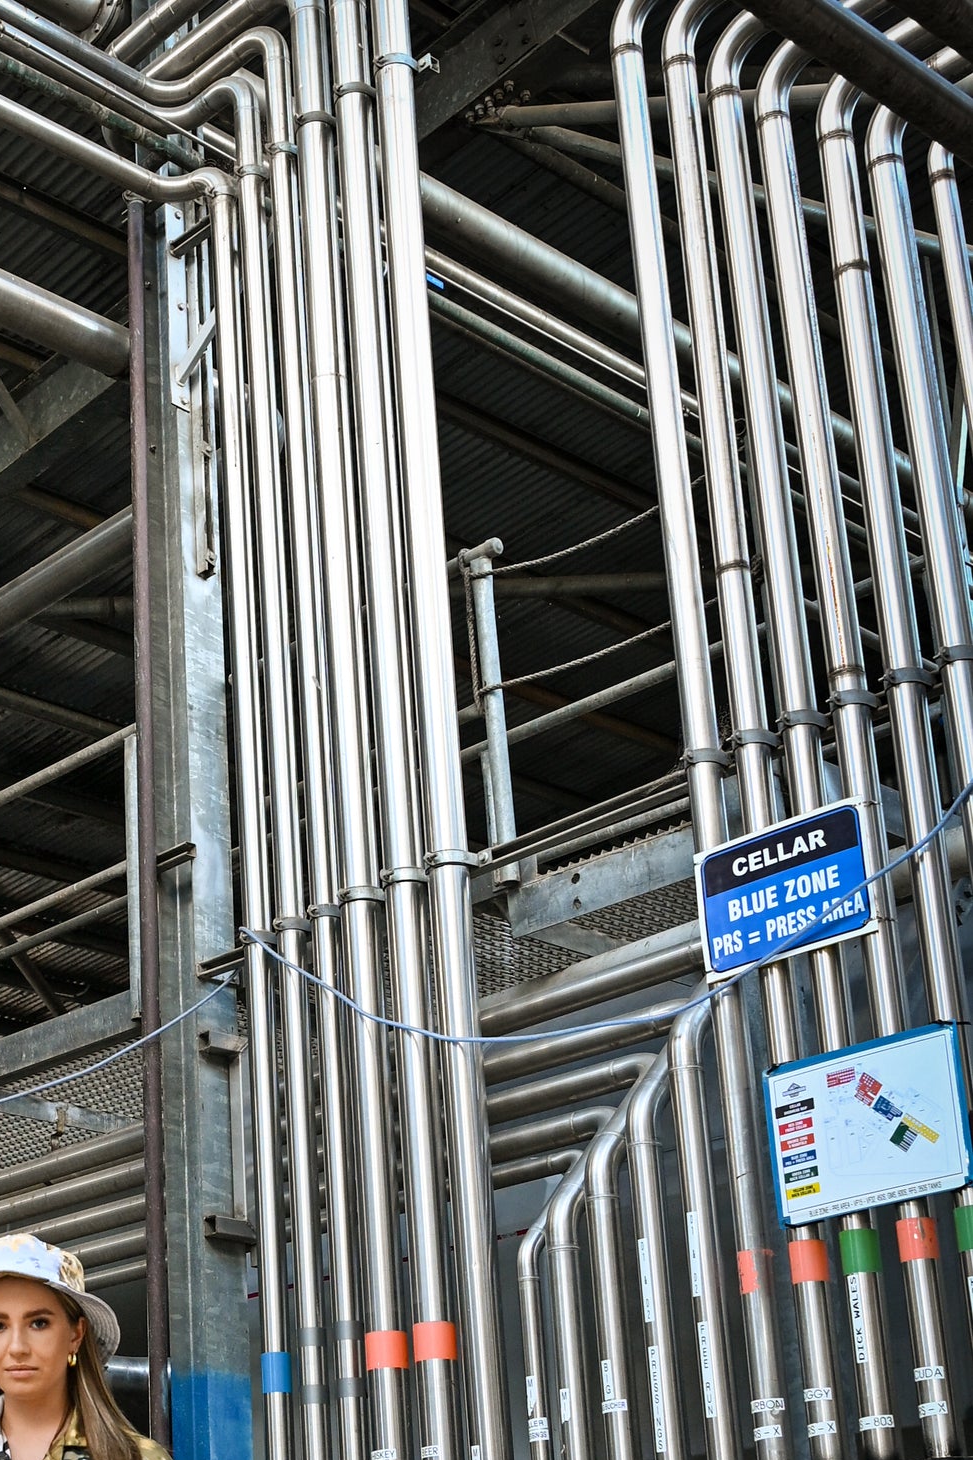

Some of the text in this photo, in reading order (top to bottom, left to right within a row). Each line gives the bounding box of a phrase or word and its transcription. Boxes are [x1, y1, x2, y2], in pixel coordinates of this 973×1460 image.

[732, 829, 827, 876] CELLAR
[728, 864, 840, 922] BLUE ZONE
[713, 891, 866, 959] PRS = PRESS AREA
[850, 1276, 865, 1361] DICK WALES
[650, 1348, 664, 1450] PRESSINGS
[873, 1416, 893, 1427] 803
